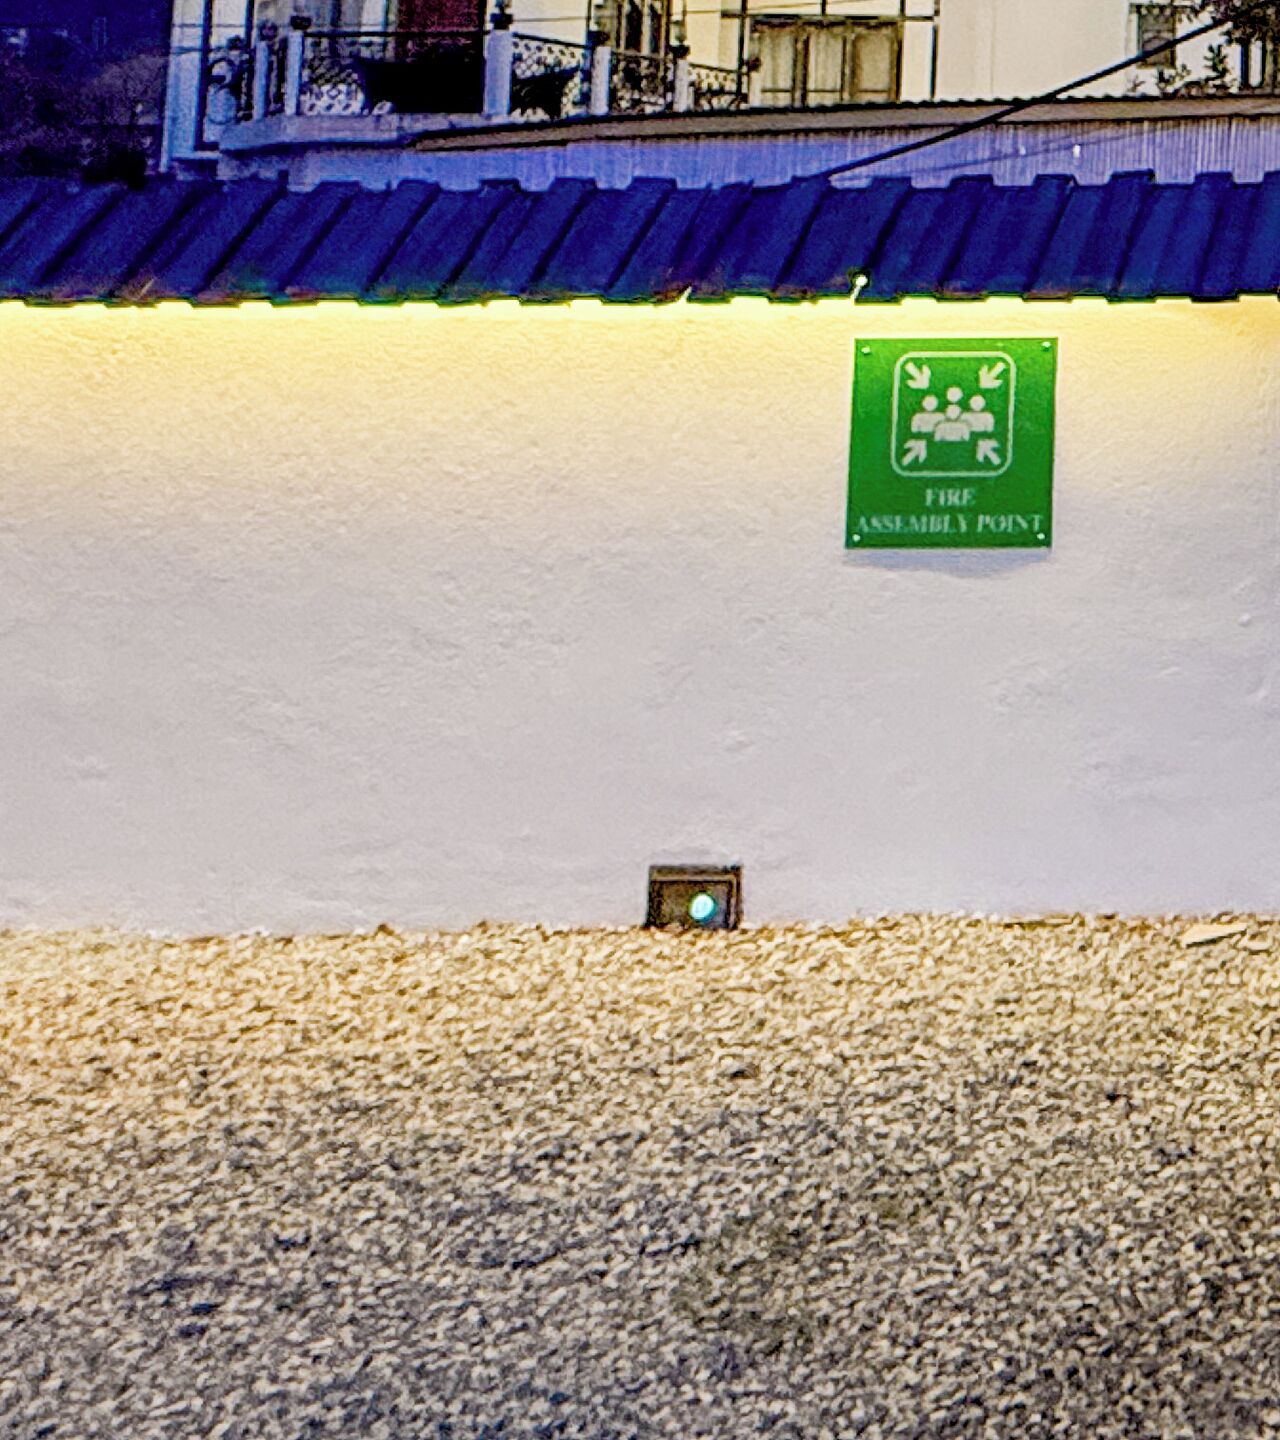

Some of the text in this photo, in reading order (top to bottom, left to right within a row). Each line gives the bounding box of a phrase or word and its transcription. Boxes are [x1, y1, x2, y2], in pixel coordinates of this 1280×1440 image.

[925, 488, 976, 507] FIRE
[857, 513, 1043, 534] ASSEMBLY POINT
